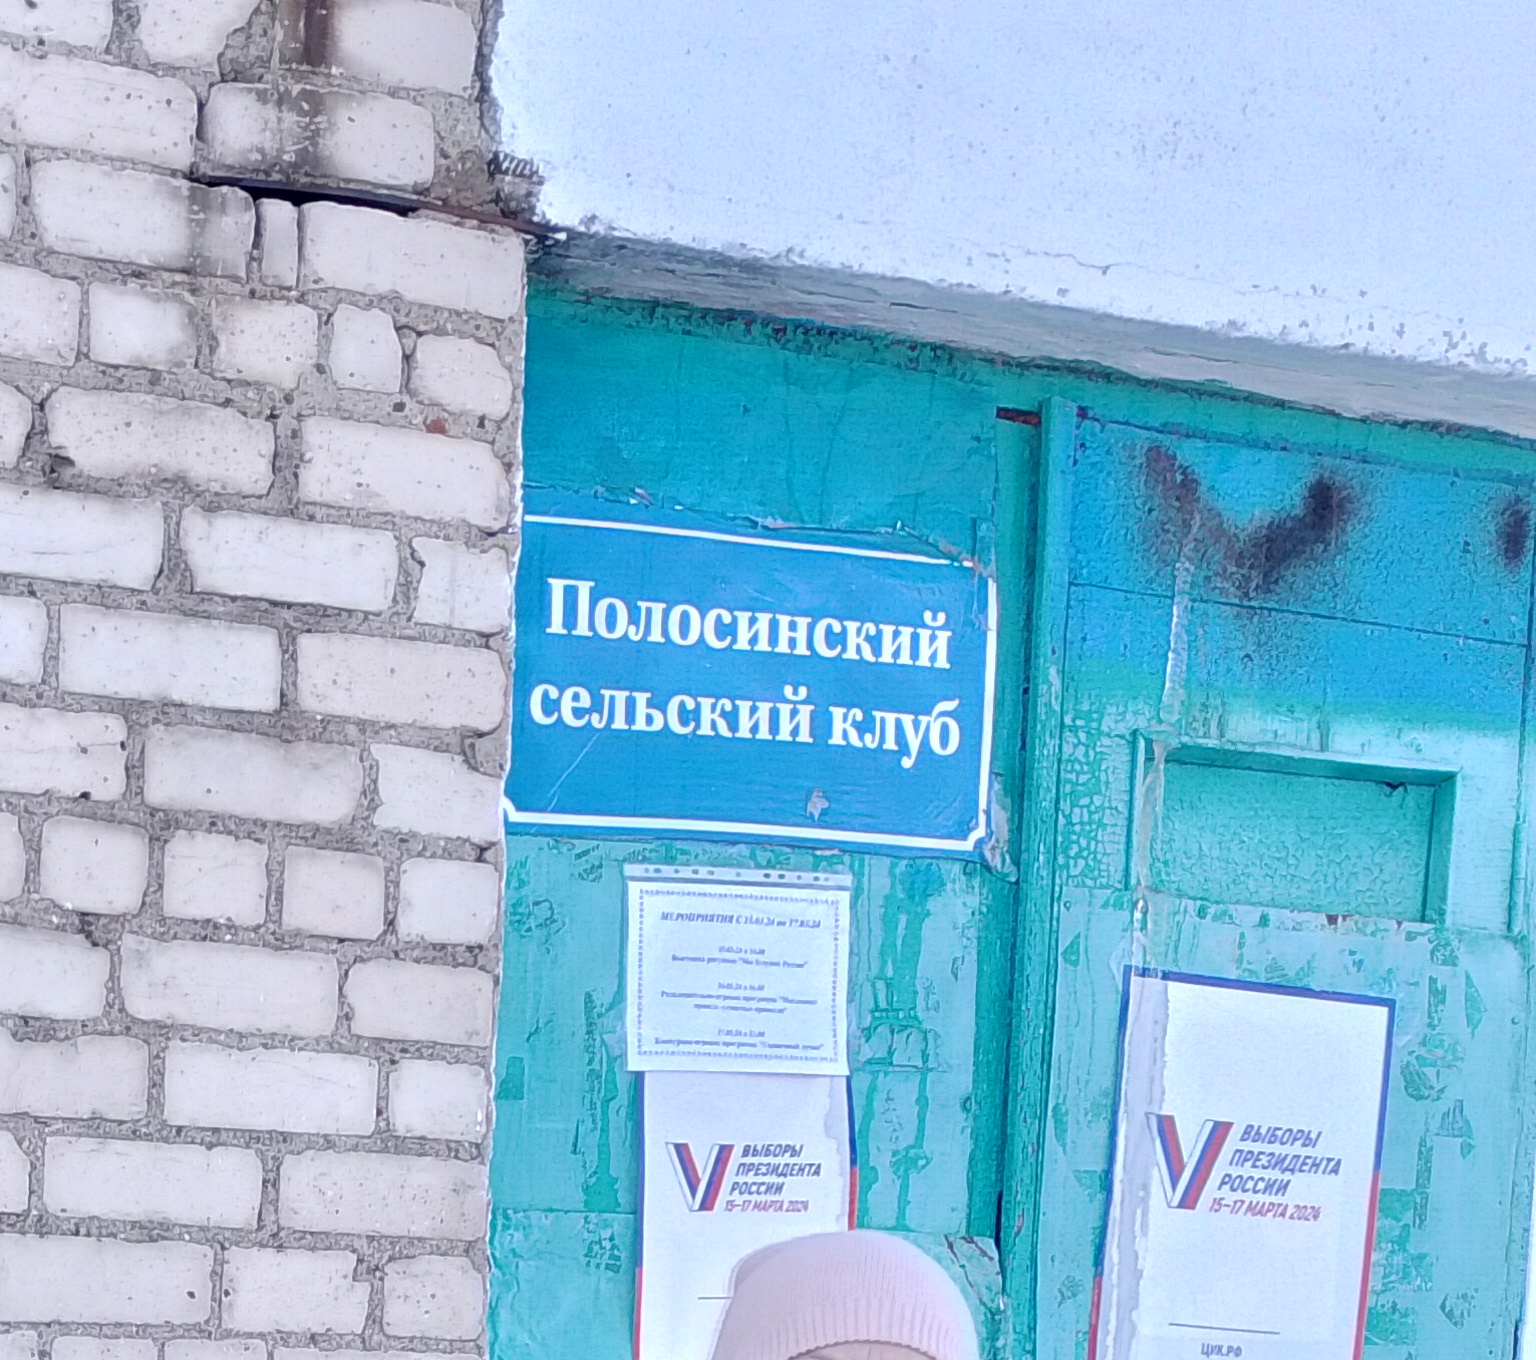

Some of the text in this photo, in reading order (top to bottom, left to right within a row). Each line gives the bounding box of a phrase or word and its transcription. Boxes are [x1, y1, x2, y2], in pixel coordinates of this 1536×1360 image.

[545, 577, 952, 669] Полосинский
[530, 683, 960, 769] сельский клуб
[1239, 1124, 1323, 1148] ВЫБОРЫ
[741, 1143, 804, 1158] ВЫБОРЫ
[735, 1163, 822, 1177] ПРЕЗИДЕНТА
[1229, 1149, 1342, 1176] ПРЕЗИДЕНТА
[729, 1181, 785, 1195] РОССИИ
[1217, 1173, 1292, 1197] РОССИИ
[751, 1200, 784, 1212] МАРТА
[785, 1200, 809, 1213] 2024
[1244, 1200, 1289, 1219] МАРТА
[1288, 1204, 1322, 1221] 2024
[1200, 1342, 1242, 1359] ЦИК.РФ
